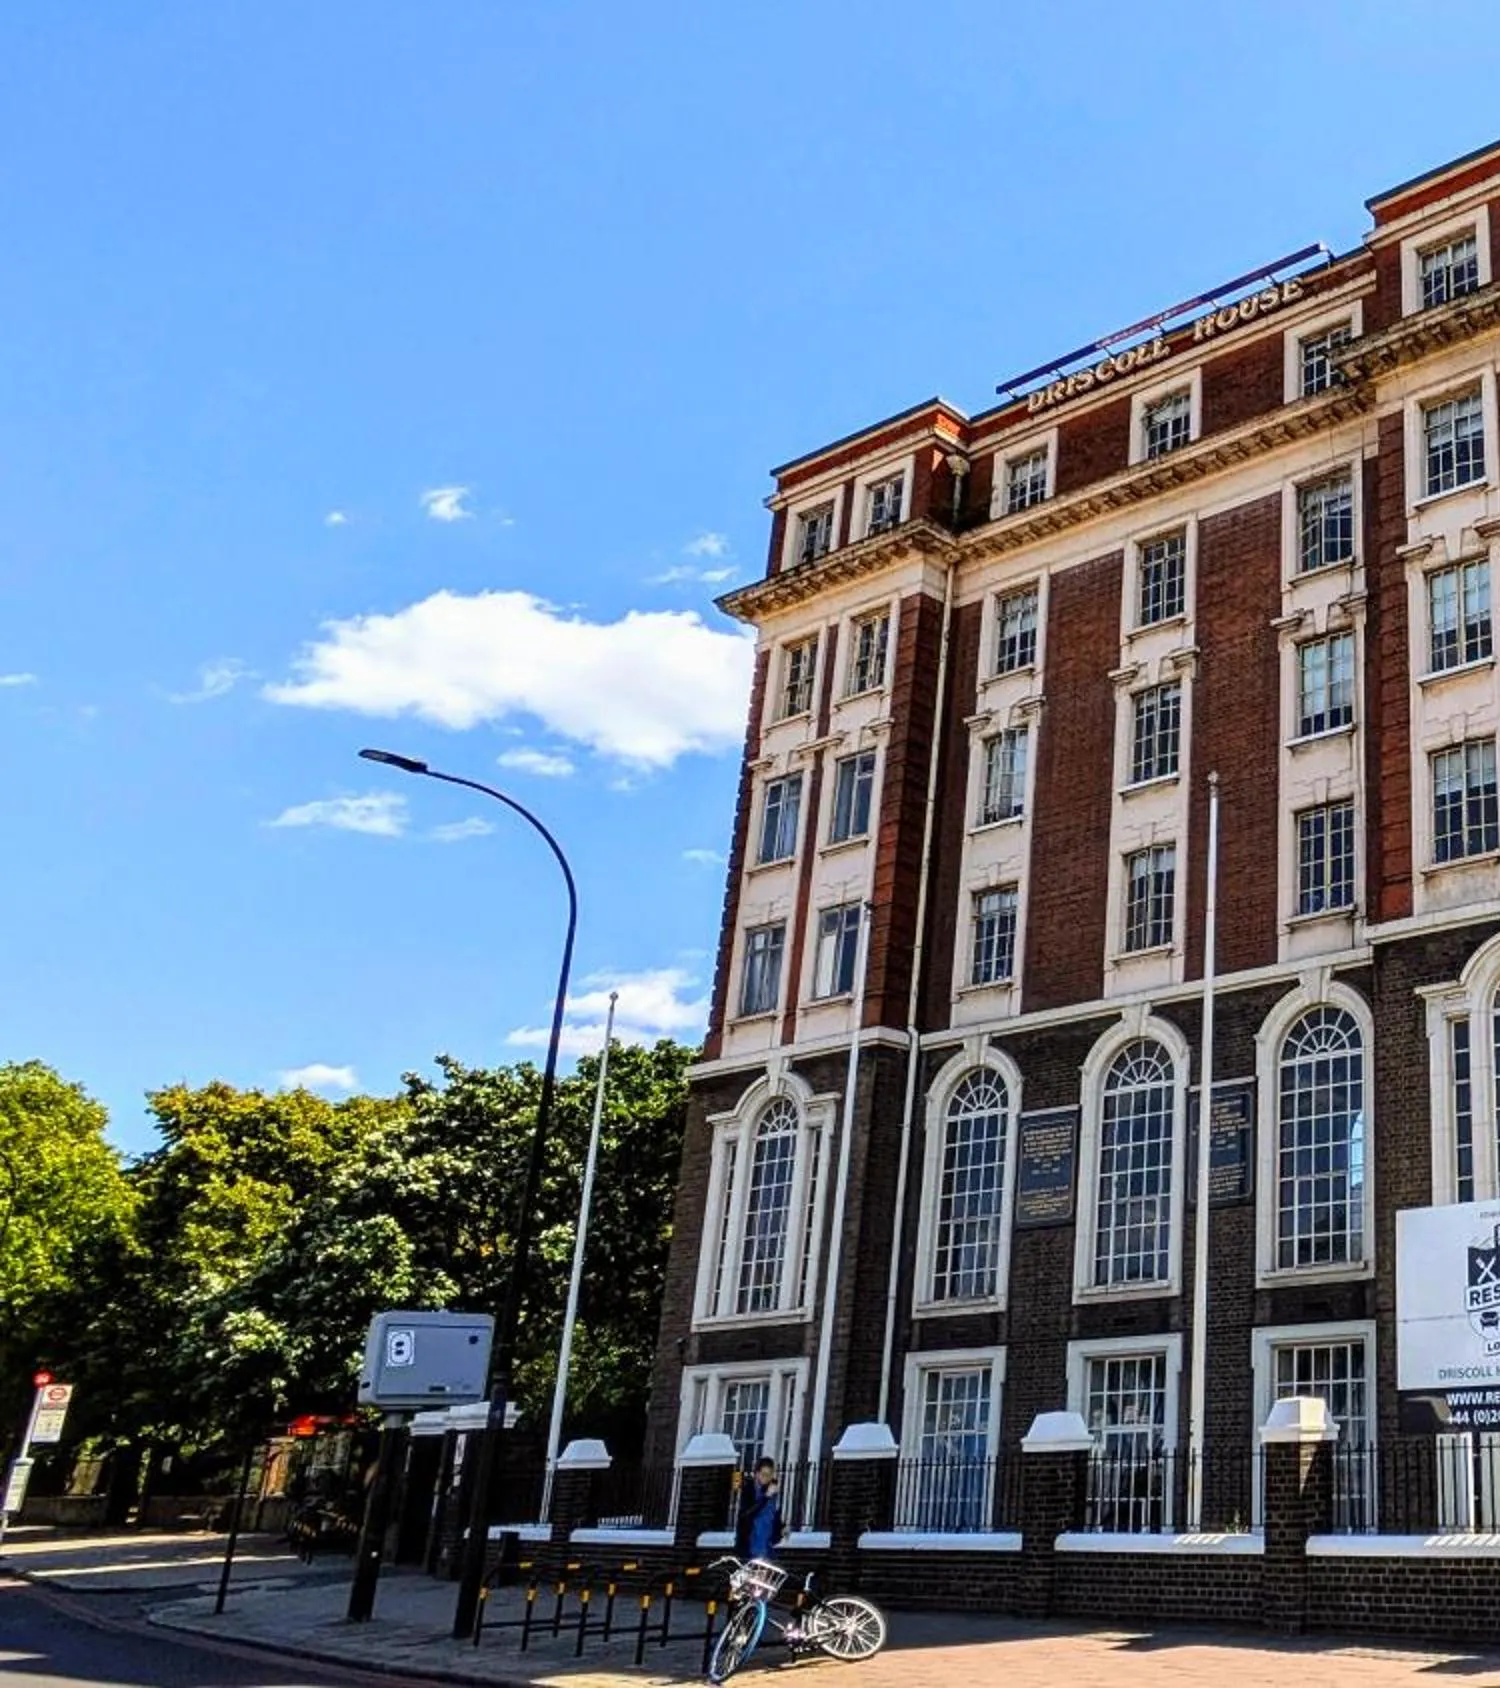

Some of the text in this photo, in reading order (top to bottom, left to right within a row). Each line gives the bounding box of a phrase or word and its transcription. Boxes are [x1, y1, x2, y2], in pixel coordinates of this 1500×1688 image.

[1027, 337, 1171, 413] DRISCOLL
[1192, 277, 1304, 342] HOUSE
[1438, 1366, 1493, 1380] DRISCOLL
